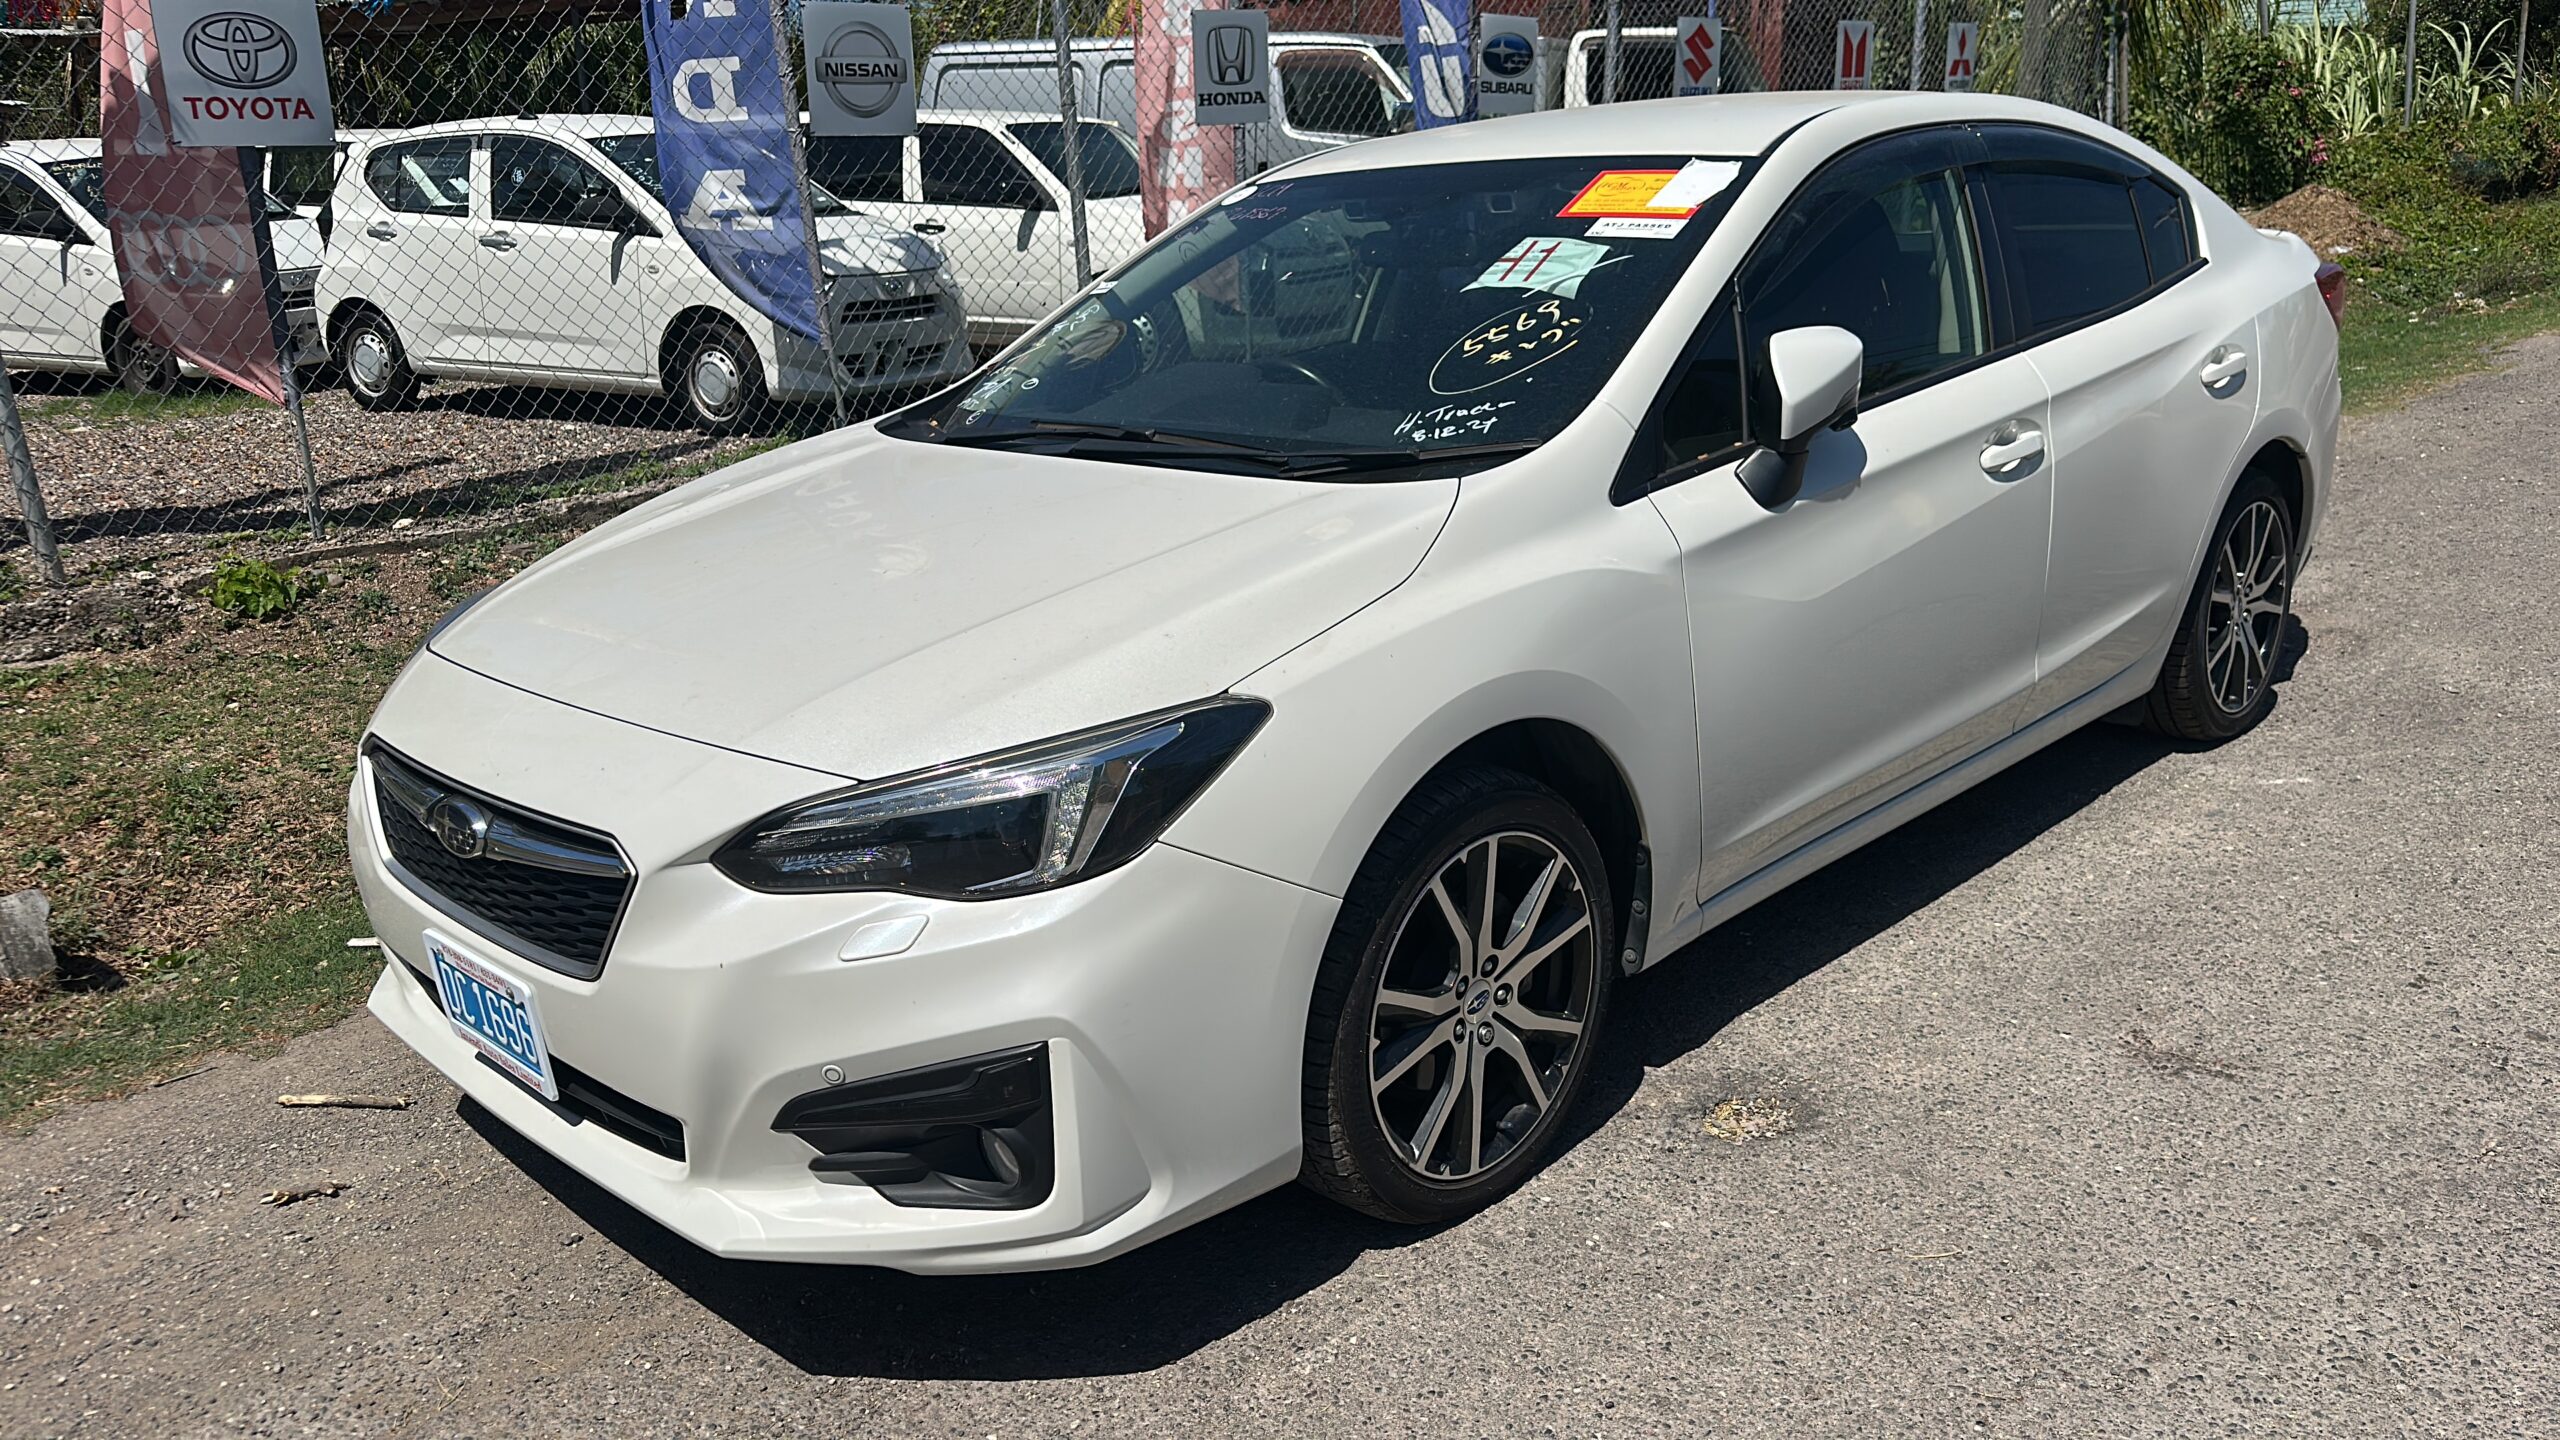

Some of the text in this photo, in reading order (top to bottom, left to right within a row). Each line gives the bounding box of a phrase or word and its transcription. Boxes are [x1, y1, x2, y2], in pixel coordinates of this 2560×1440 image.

[824, 58, 899, 80] NISSAN
[1480, 81, 1533, 95] SUBARU
[1679, 86, 1712, 97] SUZUKI
[1198, 90, 1267, 106] HONDA
[183, 96, 316, 121] TOYOTA
[472, 982, 538, 1064] 1696
